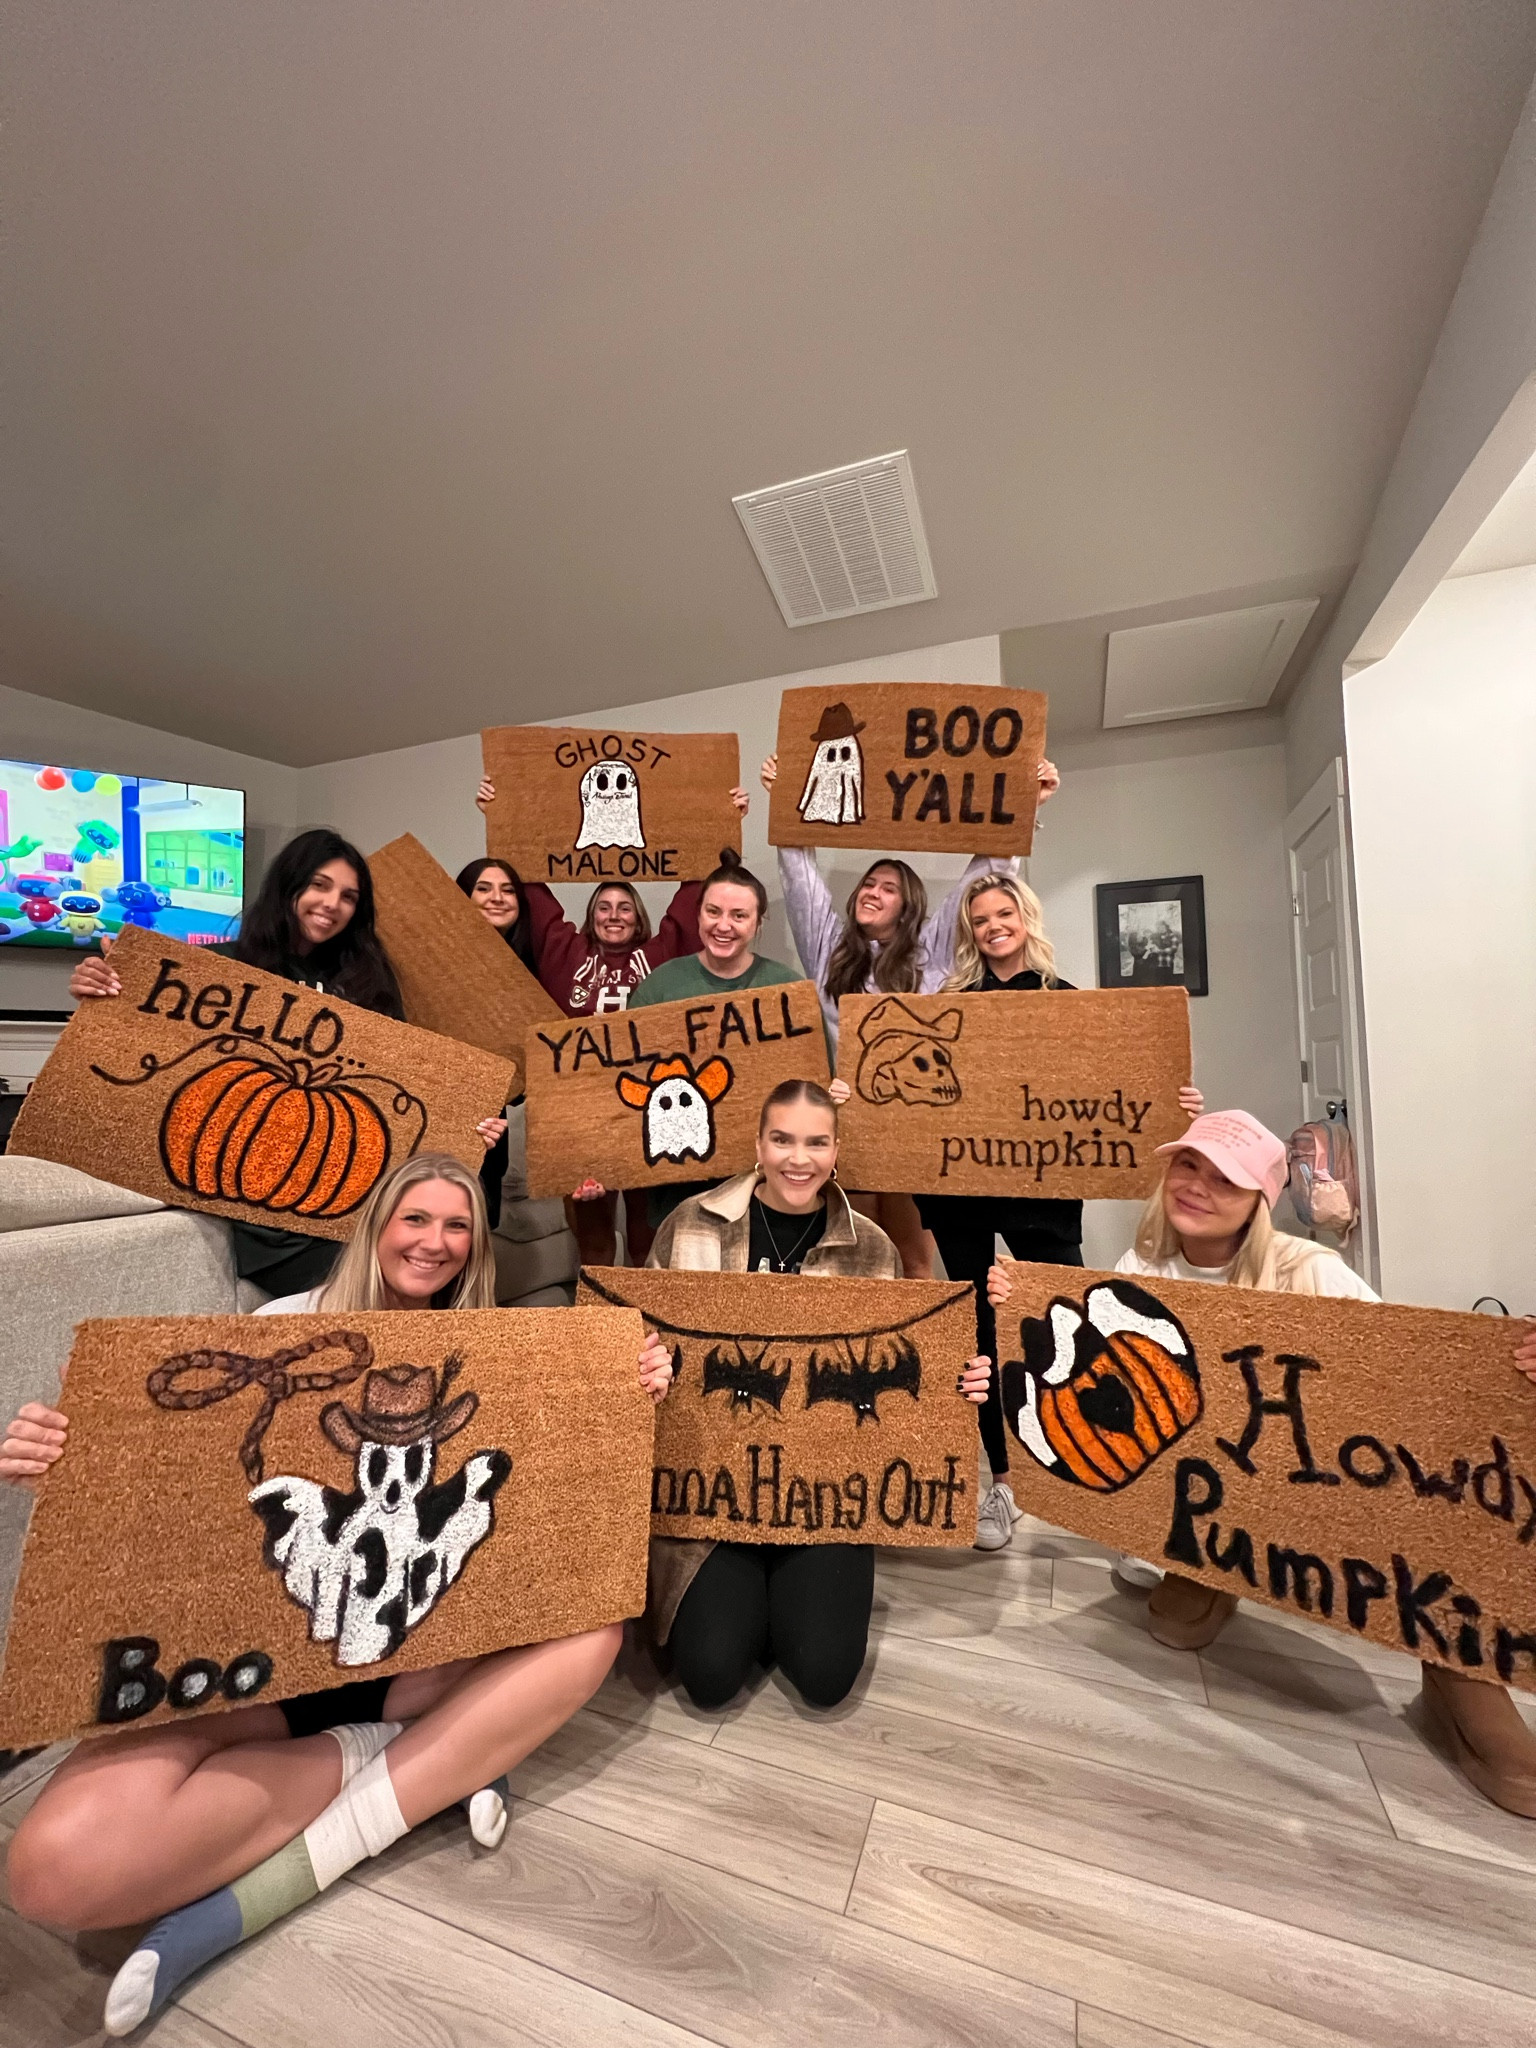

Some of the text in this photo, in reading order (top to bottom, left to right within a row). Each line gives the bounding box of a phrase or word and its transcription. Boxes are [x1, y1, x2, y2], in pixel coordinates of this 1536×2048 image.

[554, 735, 671, 769] GHOST
[904, 705, 1023, 759] BOO
[885, 768, 1015, 825] Y'ALL
[548, 850, 678, 877] MALONE
[685, 991, 813, 1054] FALL
[1019, 1084, 1151, 1133] howdy
[939, 1128, 1138, 1181] pumpkin
[96, 1635, 274, 1724] Boo
